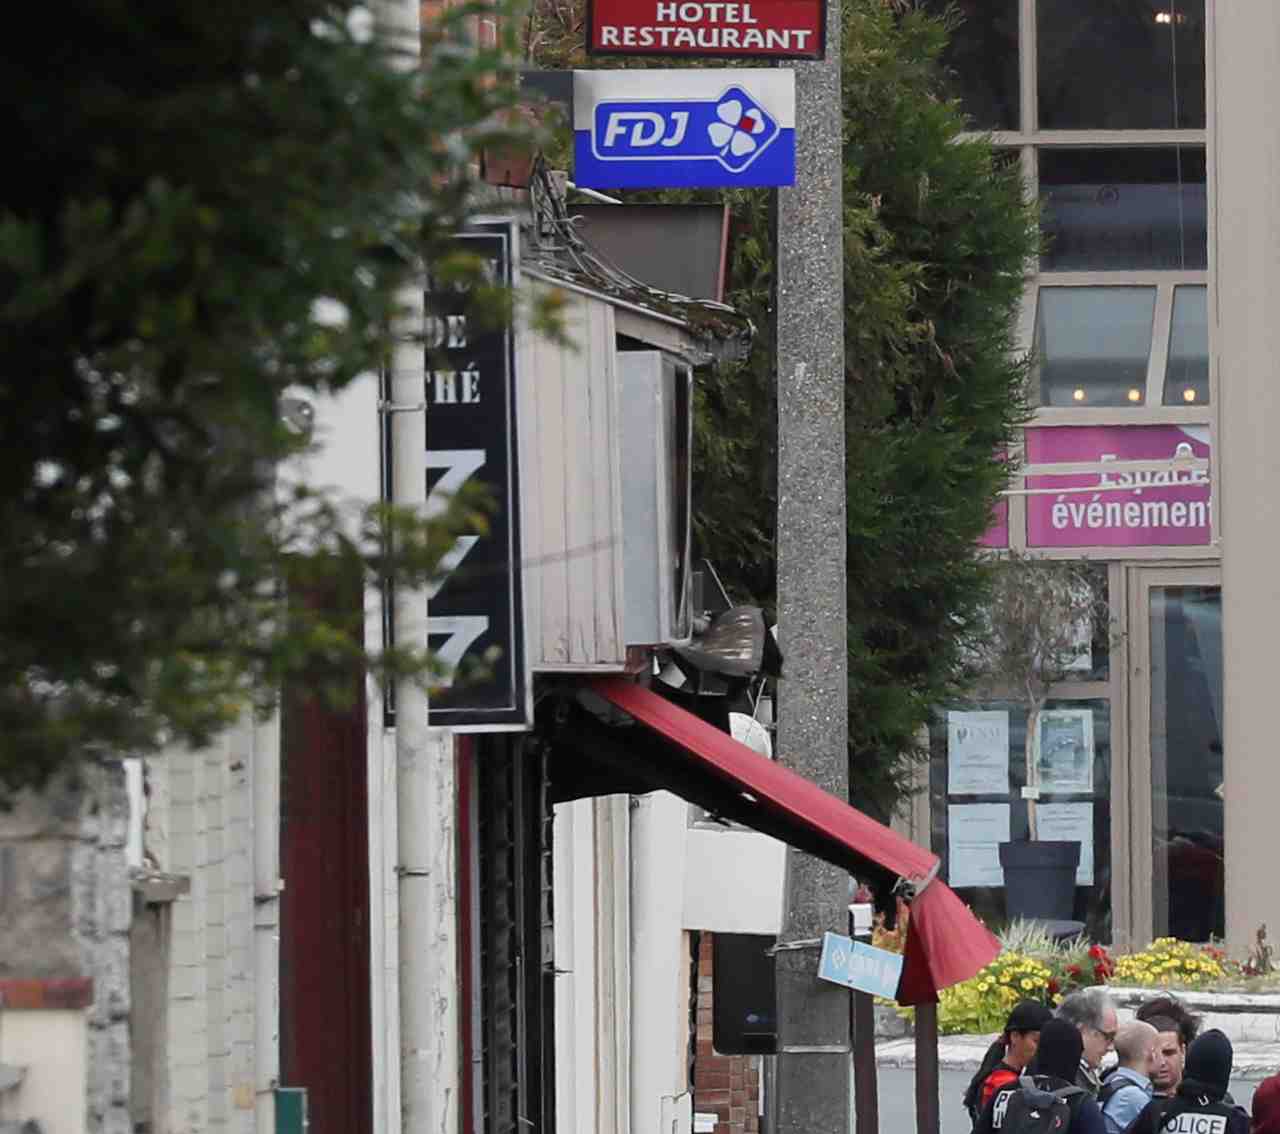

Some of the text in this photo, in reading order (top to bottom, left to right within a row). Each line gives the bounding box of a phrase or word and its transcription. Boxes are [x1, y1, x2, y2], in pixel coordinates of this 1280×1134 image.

[656, 2, 758, 24] HOTEL
[601, 26, 811, 49] RESTAURANT
[603, 111, 689, 148] FDJ
[1051, 494, 1213, 529] événemen
